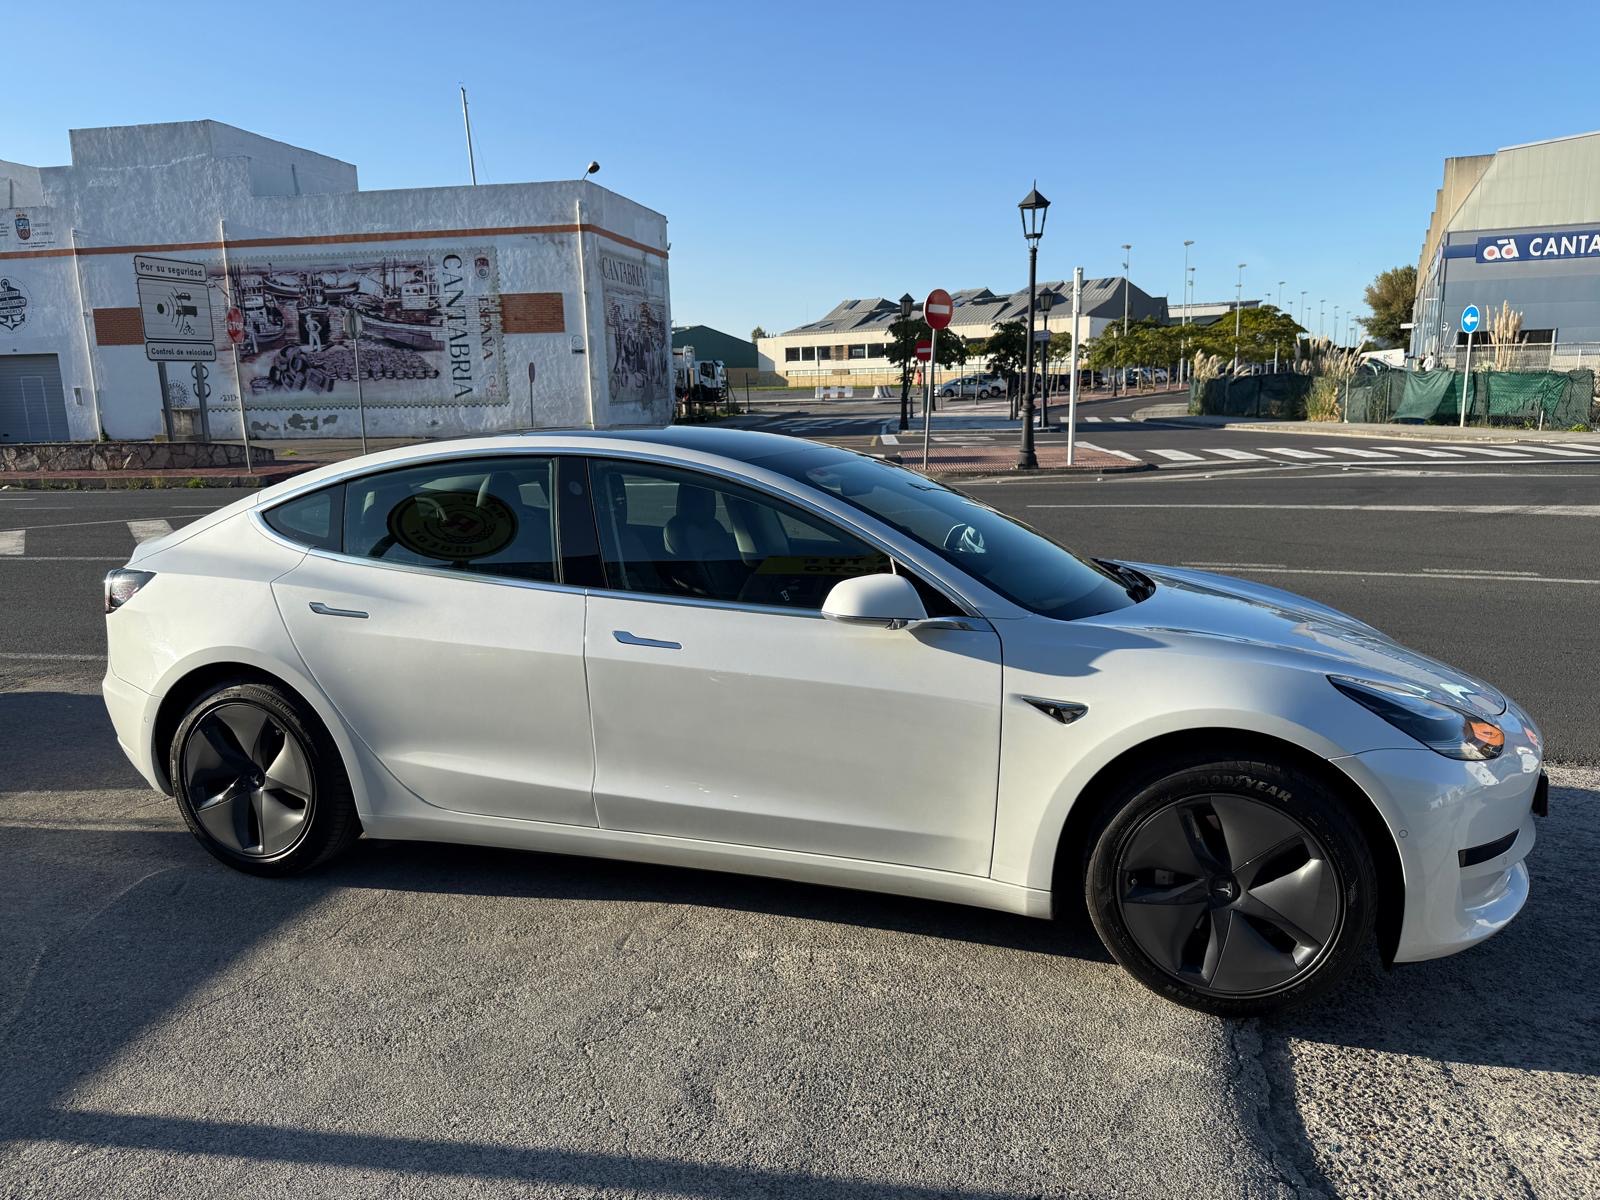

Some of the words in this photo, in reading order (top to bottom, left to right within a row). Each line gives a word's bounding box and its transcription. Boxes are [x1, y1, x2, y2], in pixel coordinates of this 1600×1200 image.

[140, 261, 153, 271] Por
[156, 264, 165, 273] su
[168, 266, 203, 277] seguridad
[602, 256, 646, 288] CANTABRIA
[228, 321, 244, 331] STOP
[442, 254, 473, 398] CANTABRIA
[478, 297, 495, 360] ESPAÑA
[151, 347, 175, 355] Control
[185, 348, 213, 356] velocidad
